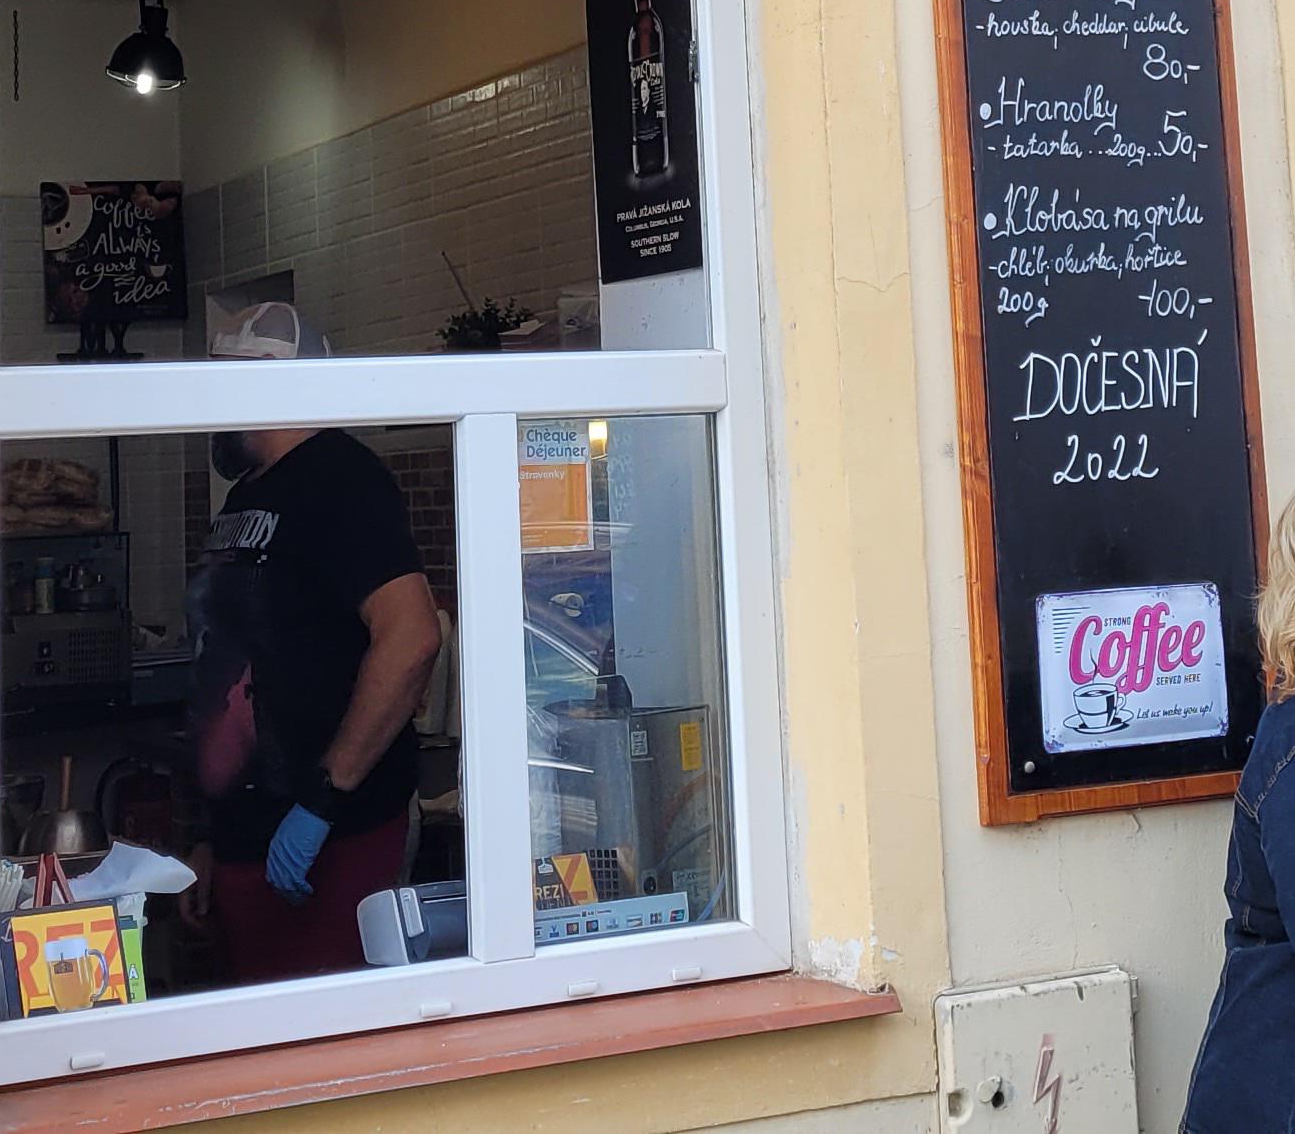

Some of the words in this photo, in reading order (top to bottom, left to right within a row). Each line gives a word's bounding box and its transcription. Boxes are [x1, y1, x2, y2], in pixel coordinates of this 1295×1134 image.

[1133, 11, 1190, 35] cibule
[1143, 44, 1201, 84] 80,-
[984, 76, 1118, 136] Hranolky
[93, 194, 155, 228] Coffee
[671, 197, 691, 211] KOLA
[992, 183, 1110, 240] Klobása
[1114, 206, 1142, 230] na
[1135, 193, 1204, 243] grilu
[640, 247, 657, 257] SINCE
[113, 276, 171, 305] idea
[1013, 329, 1208, 422] DOČESNÁ
[526, 429, 577, 444] Chèque
[526, 444, 586, 461] Déjeuner
[1053, 434, 1159, 485] 2022
[1104, 616, 1131, 627] STRONG
[1069, 602, 1206, 695] Coffee
[1156, 676, 1182, 686] SERVED
[1183, 673, 1202, 684] HERE
